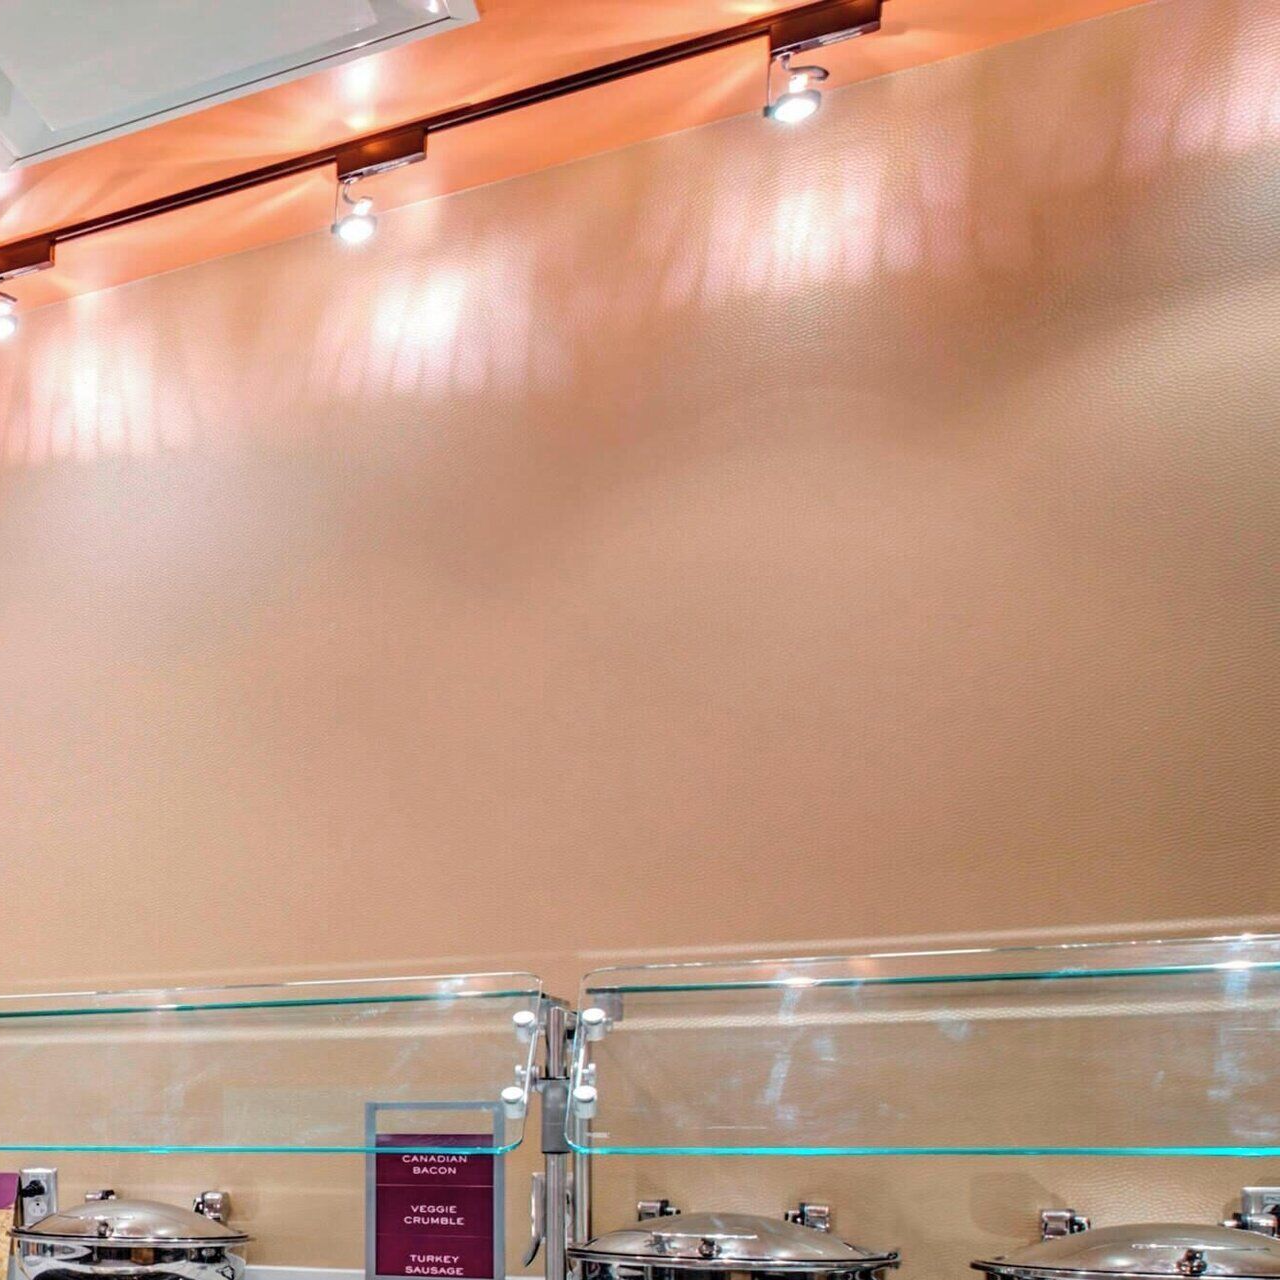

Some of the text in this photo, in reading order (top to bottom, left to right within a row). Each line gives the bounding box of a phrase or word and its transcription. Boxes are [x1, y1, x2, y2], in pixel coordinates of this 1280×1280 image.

[402, 1154, 468, 1164] CANADIAN
[412, 1166, 457, 1175] BACON
[411, 1204, 457, 1214] VEGGIE
[403, 1216, 465, 1226] CRUMBLE
[409, 1254, 460, 1264] TURKEY
[405, 1266, 464, 1276] SAUSAGE
